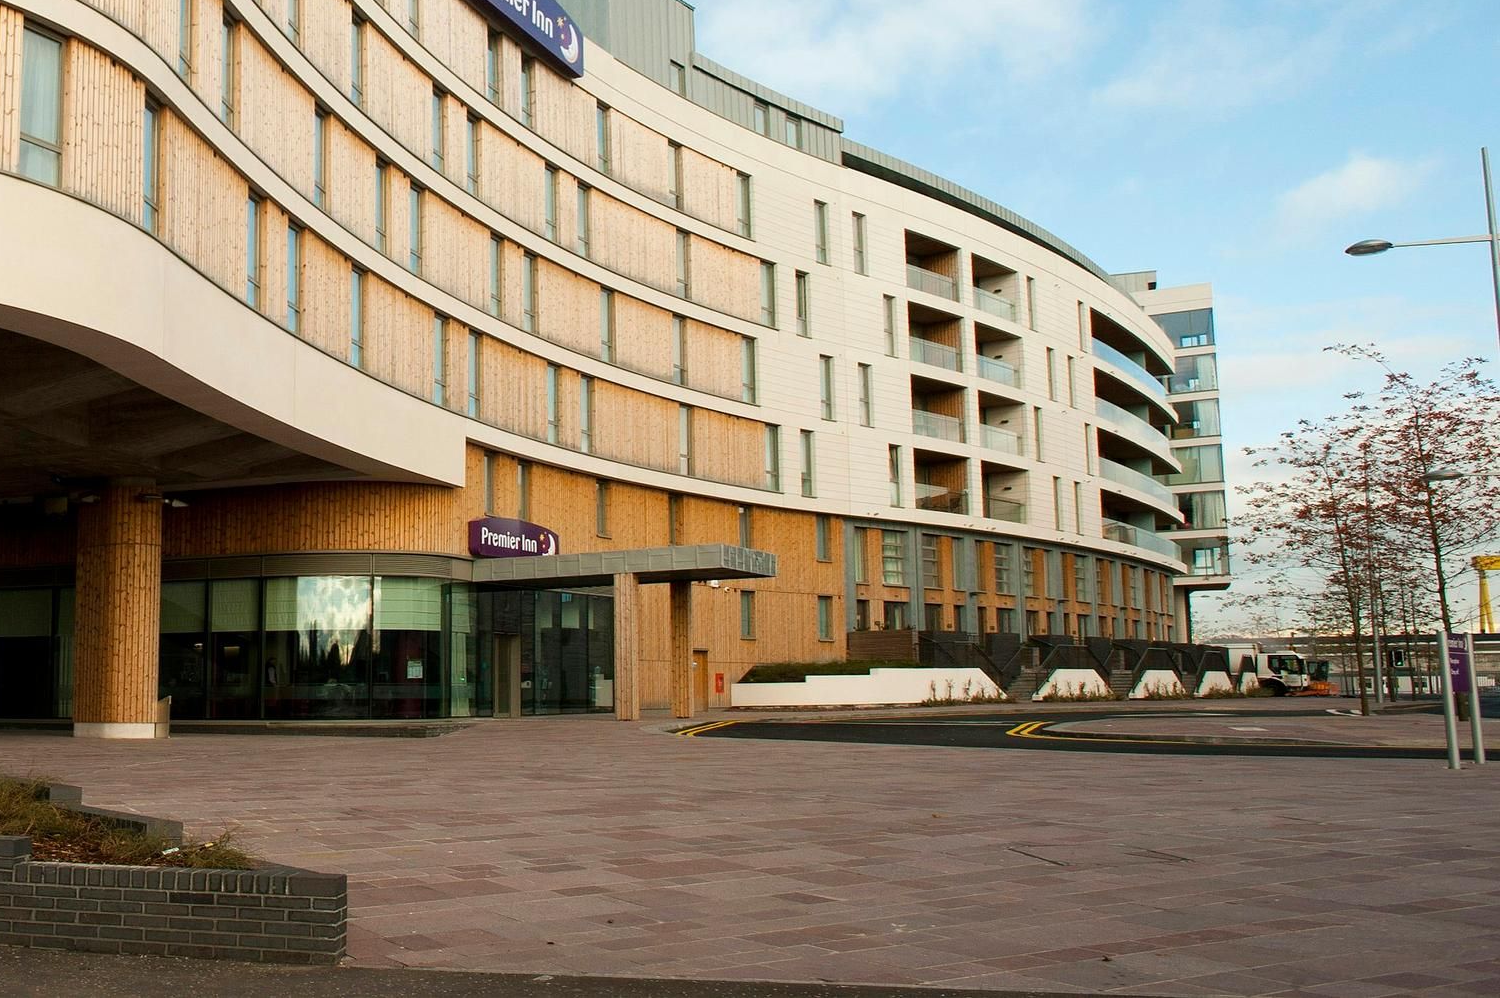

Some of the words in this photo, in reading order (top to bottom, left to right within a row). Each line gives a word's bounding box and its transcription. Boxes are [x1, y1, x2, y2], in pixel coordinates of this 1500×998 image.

[531, 0, 554, 39] Inn
[481, 527, 521, 550] Premier
[521, 534, 537, 553] Inn
